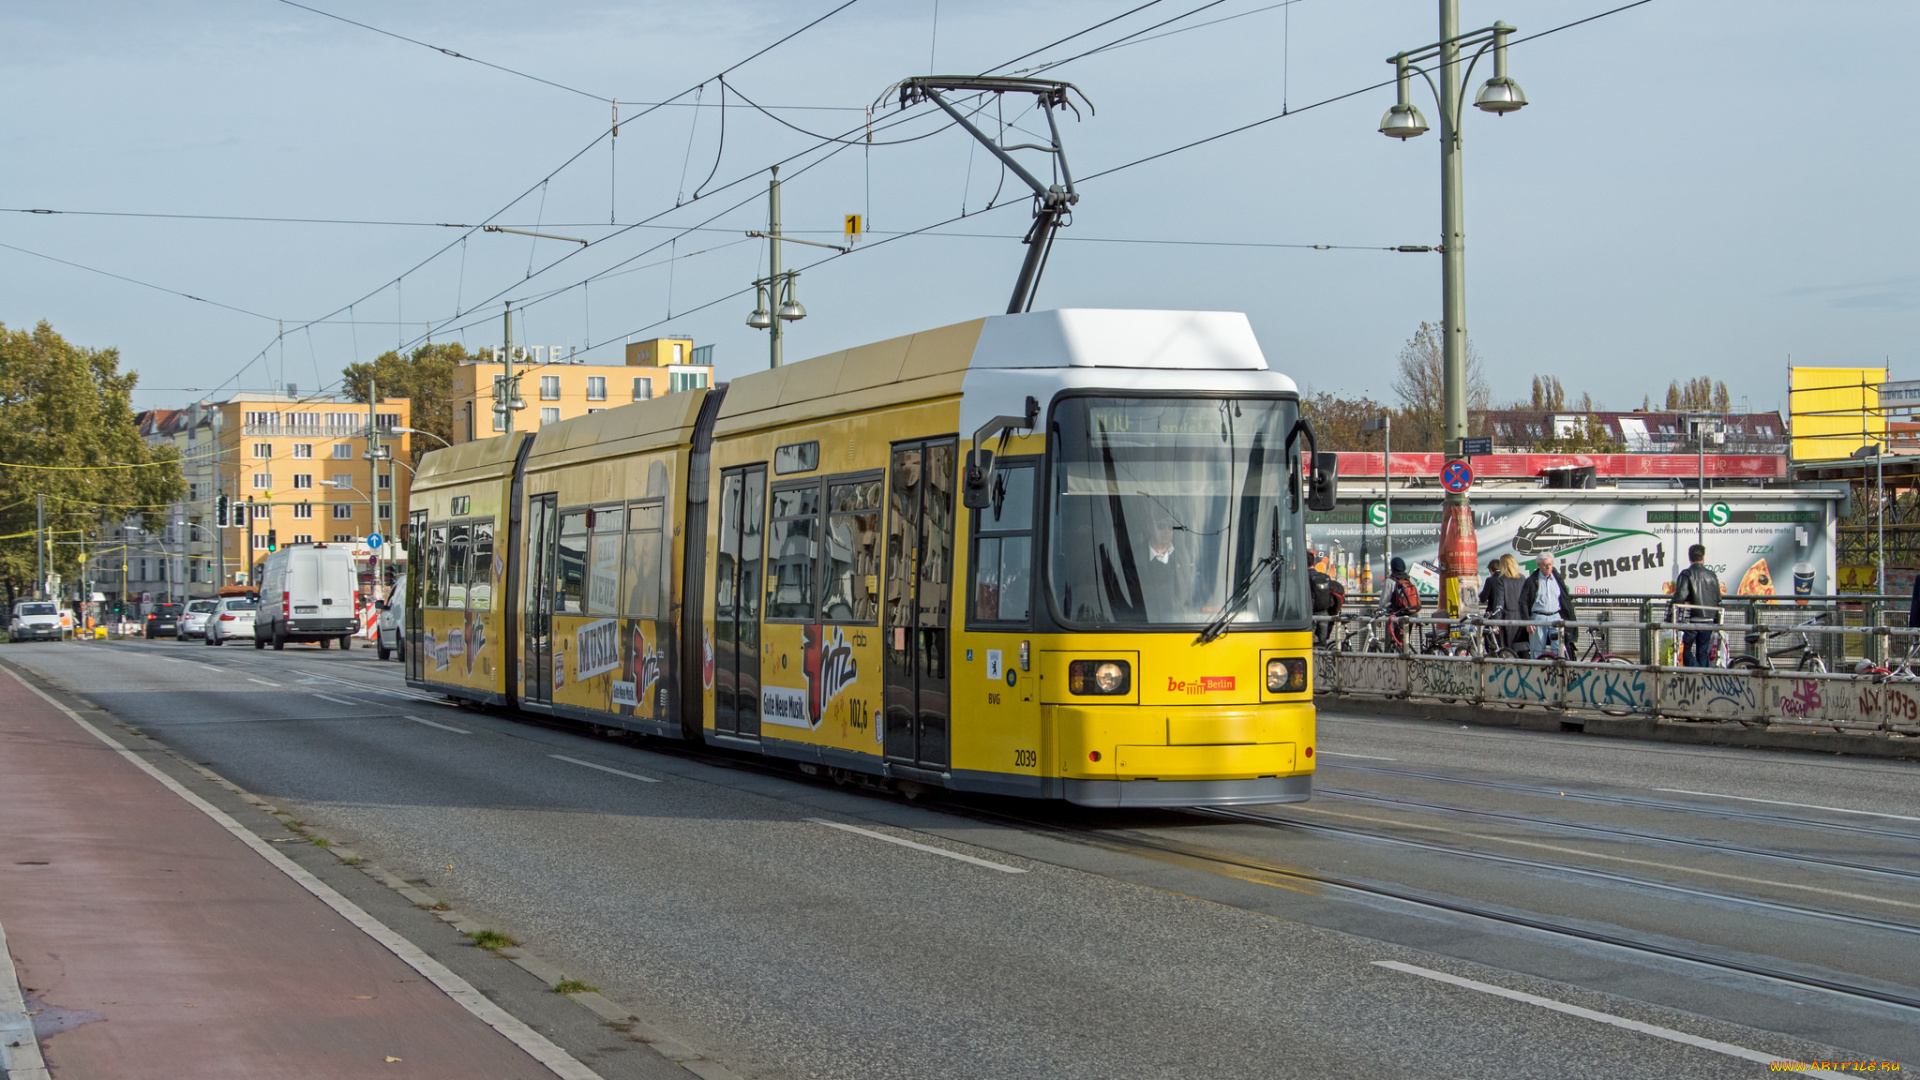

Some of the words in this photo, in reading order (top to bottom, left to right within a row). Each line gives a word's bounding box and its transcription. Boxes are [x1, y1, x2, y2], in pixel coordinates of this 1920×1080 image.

[847, 215, 856, 234] 1
[492, 344, 581, 363] HOTEL
[1306, 513, 1363, 522] AHRSCHEINE
[1400, 513, 1432, 522] TICKETS
[1480, 511, 1508, 526] Ihr
[1712, 503, 1727, 525] S
[1423, 528, 1437, 536] und
[1746, 545, 1775, 554] PIZZA
[579, 620, 618, 673] MUSIK
[852, 630, 867, 647] rbb
[1167, 676, 1185, 691] be
[1207, 679, 1232, 689] Berlin
[763, 692, 775, 716] Gute
[775, 693, 788, 718] Neue
[988, 693, 1000, 704] BVG
[1888, 689, 1918, 720] 1973
[1015, 749, 1037, 767] 2039
